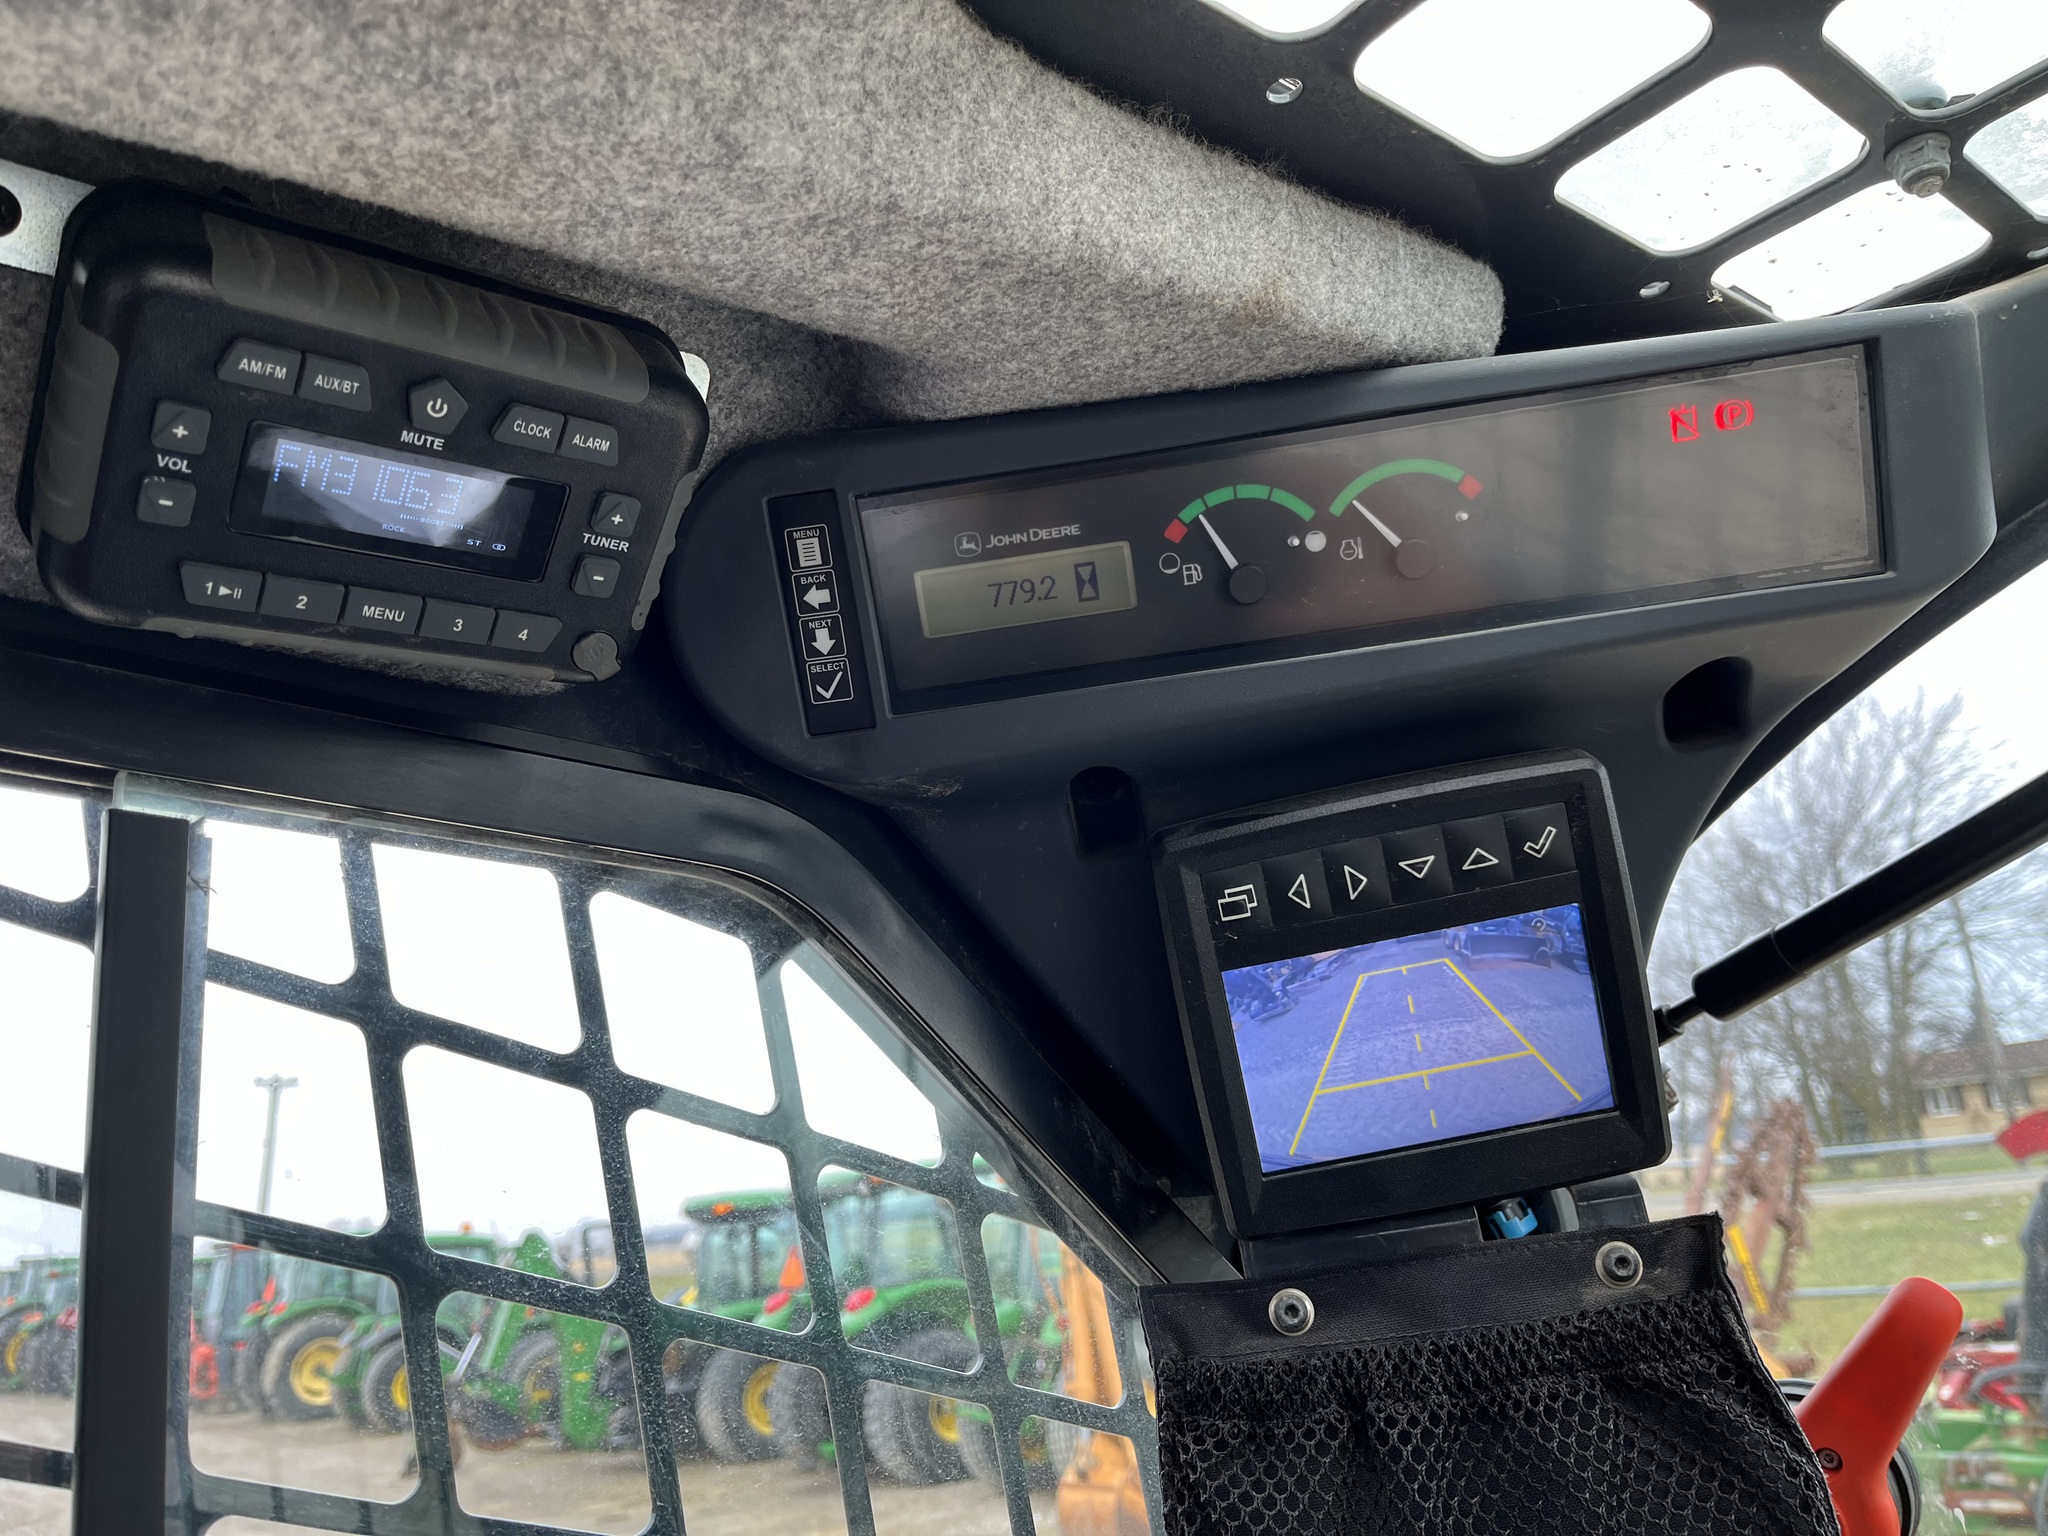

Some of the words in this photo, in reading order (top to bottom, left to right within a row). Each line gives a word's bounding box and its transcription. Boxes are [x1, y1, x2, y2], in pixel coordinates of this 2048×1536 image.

[238, 358, 287, 380] AM/FM
[314, 374, 360, 396] AUX/BT
[513, 420, 552, 439] CLOCK
[400, 430, 445, 451] MUTE
[572, 434, 610, 452] ALARM
[156, 454, 192, 474] VOL
[273, 444, 359, 496] FM3
[372, 464, 464, 516] 106.3
[382, 523, 405, 533] ROCK
[793, 528, 820, 539] MENU
[986, 532, 1028, 549] JOHN
[1029, 524, 1081, 541] DEERE
[466, 539, 482, 547] ST
[582, 532, 630, 552] TUNER
[205, 581, 213, 595] 1
[800, 574, 827, 585] BACK
[987, 575, 1058, 607] 779.2
[295, 595, 308, 609] 2
[362, 605, 405, 623] MENU
[453, 618, 463, 632] 3
[808, 619, 832, 629] NEXT
[518, 628, 529, 641] 4
[810, 661, 845, 673] SELECT
